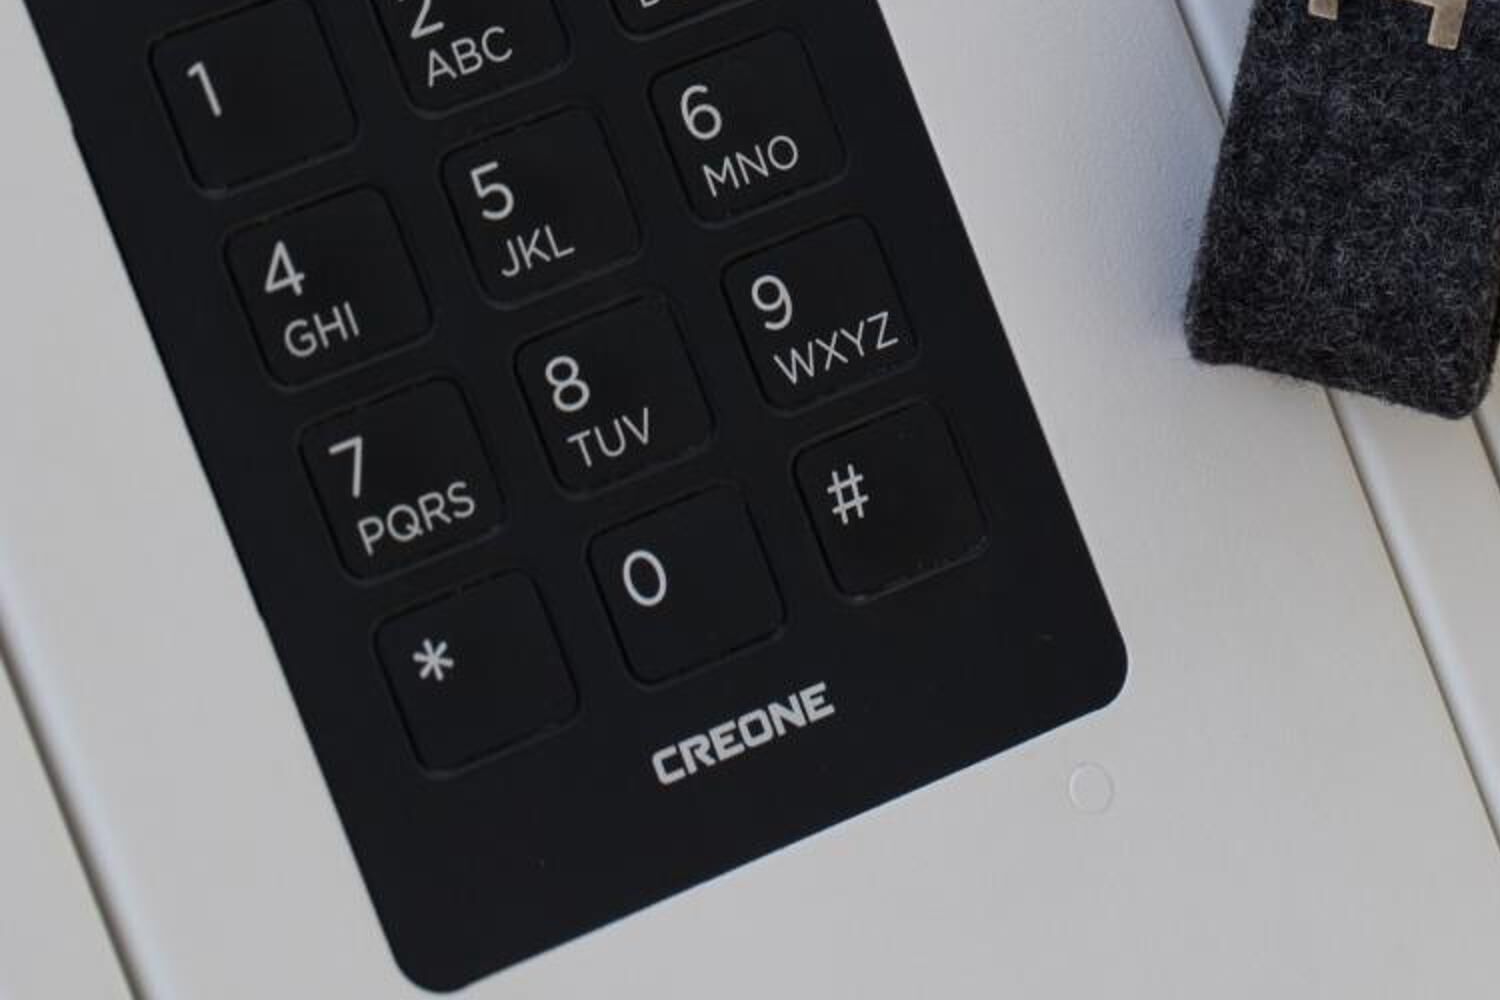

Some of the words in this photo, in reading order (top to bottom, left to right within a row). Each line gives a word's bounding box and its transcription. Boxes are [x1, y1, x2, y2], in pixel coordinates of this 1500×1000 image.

[428, 26, 513, 87] ABC
[187, 62, 221, 116] 1
[680, 84, 722, 140] 6
[470, 161, 514, 220] 5
[702, 135, 799, 197] MNO
[265, 241, 305, 295] 4
[502, 225, 575, 277] JKL
[284, 302, 359, 357] GHI
[751, 275, 793, 331] 9
[773, 311, 899, 385] WXYZ
[545, 355, 590, 412] 8
[329, 436, 363, 497] 7
[567, 407, 649, 467] TUV
[357, 481, 475, 555] PQRS
[827, 464, 869, 525] #
[623, 549, 667, 607] 0
[652, 682, 835, 785] CREONE
